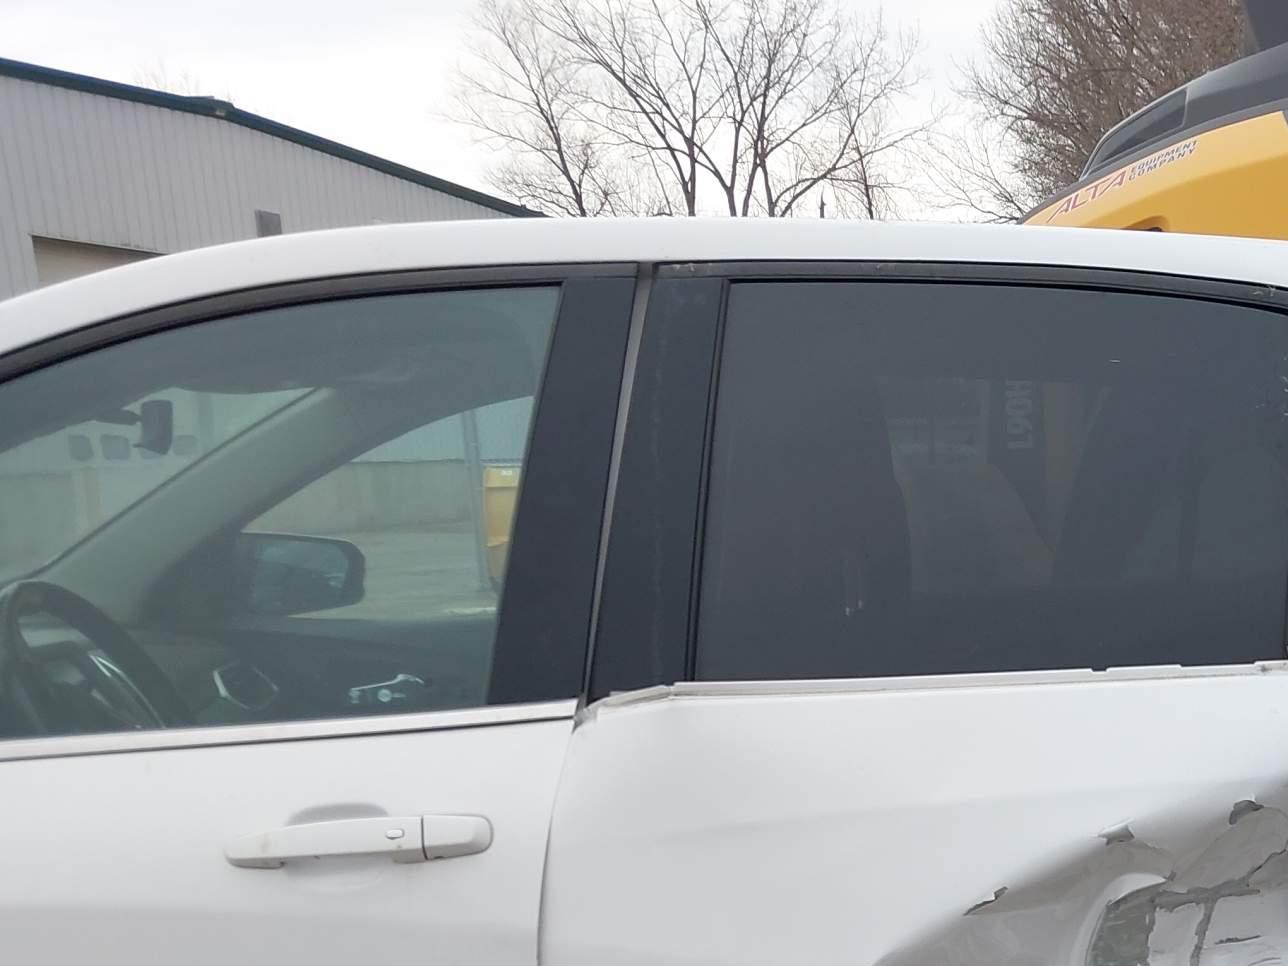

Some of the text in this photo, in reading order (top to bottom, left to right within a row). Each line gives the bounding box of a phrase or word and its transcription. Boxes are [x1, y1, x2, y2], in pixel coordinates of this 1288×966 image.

[1128, 149, 1196, 181] COMPANY
[1130, 141, 1198, 173] EQUIPMENT
[1046, 170, 1126, 224] ALTA
